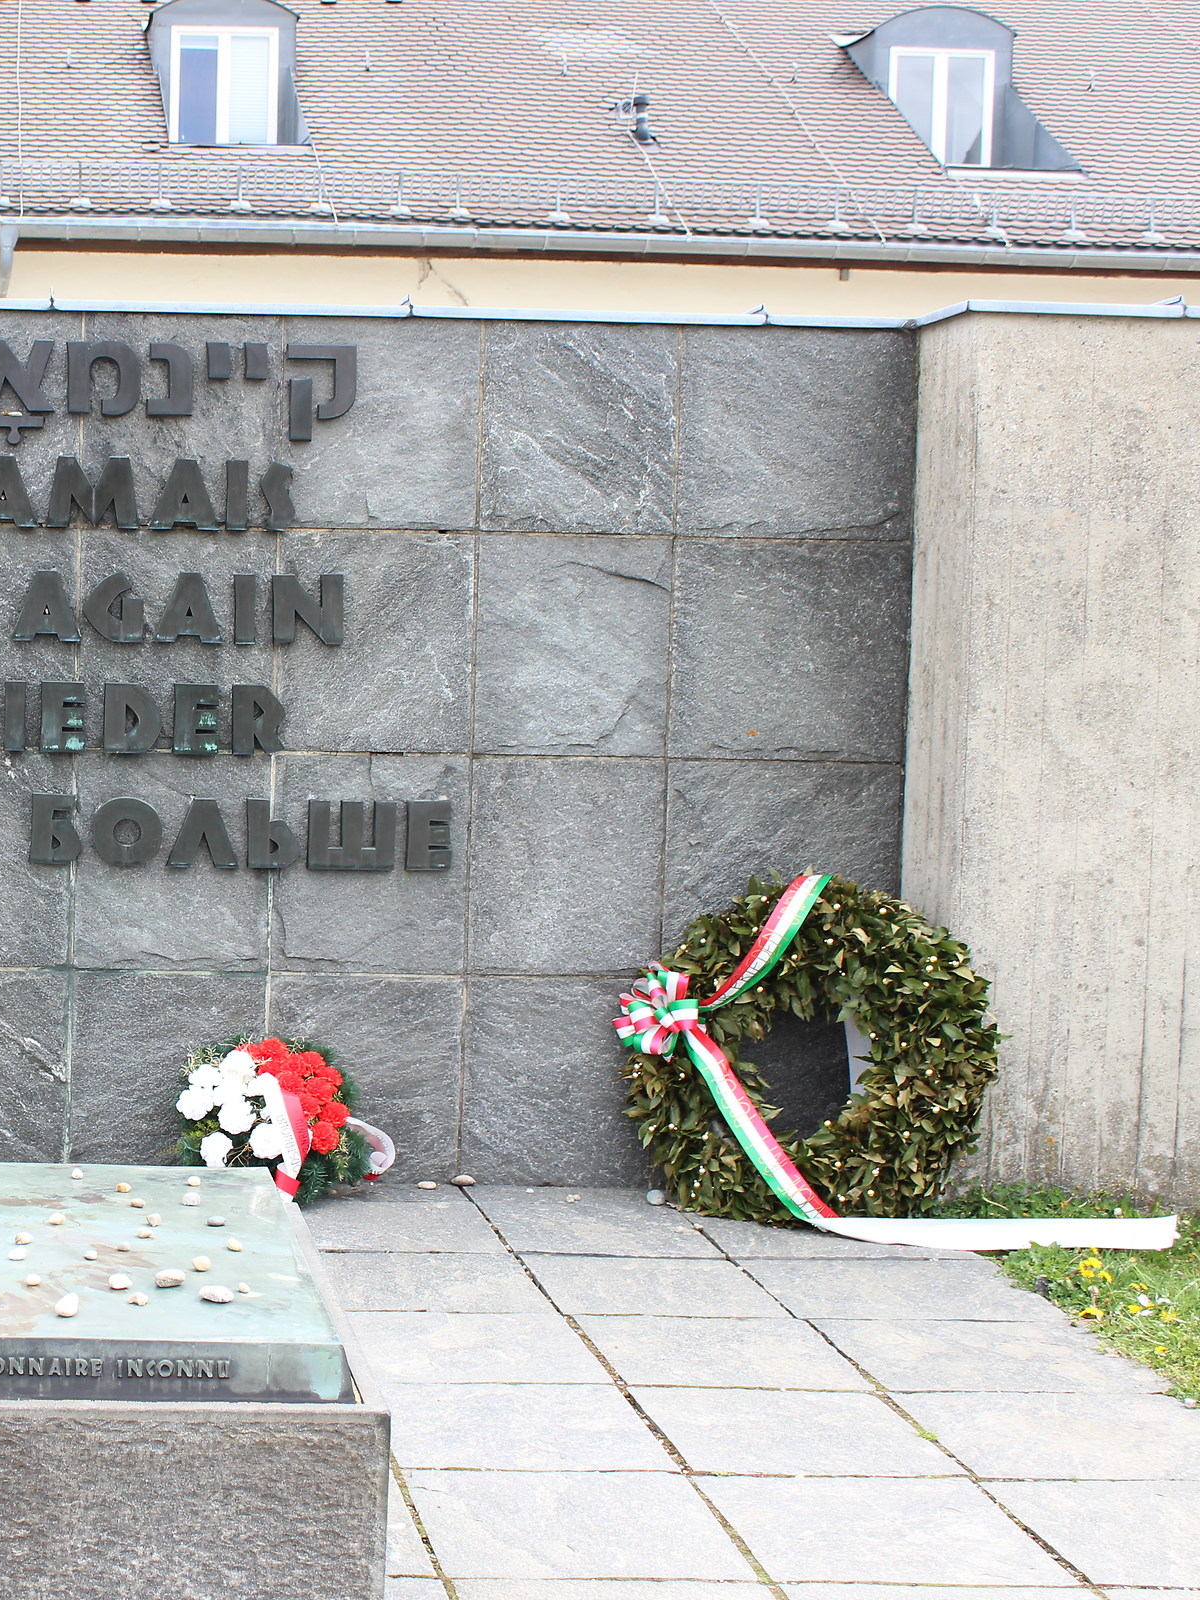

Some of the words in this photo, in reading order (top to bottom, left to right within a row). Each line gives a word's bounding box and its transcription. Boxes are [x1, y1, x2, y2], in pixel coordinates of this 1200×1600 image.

[13, 570, 344, 645] AGAIN
[30, 793, 453, 871] БОЛЬШЕ
[276, 1114, 302, 1175] ODSTAWOWA
[116, 1358, 230, 1378] INCONNU
